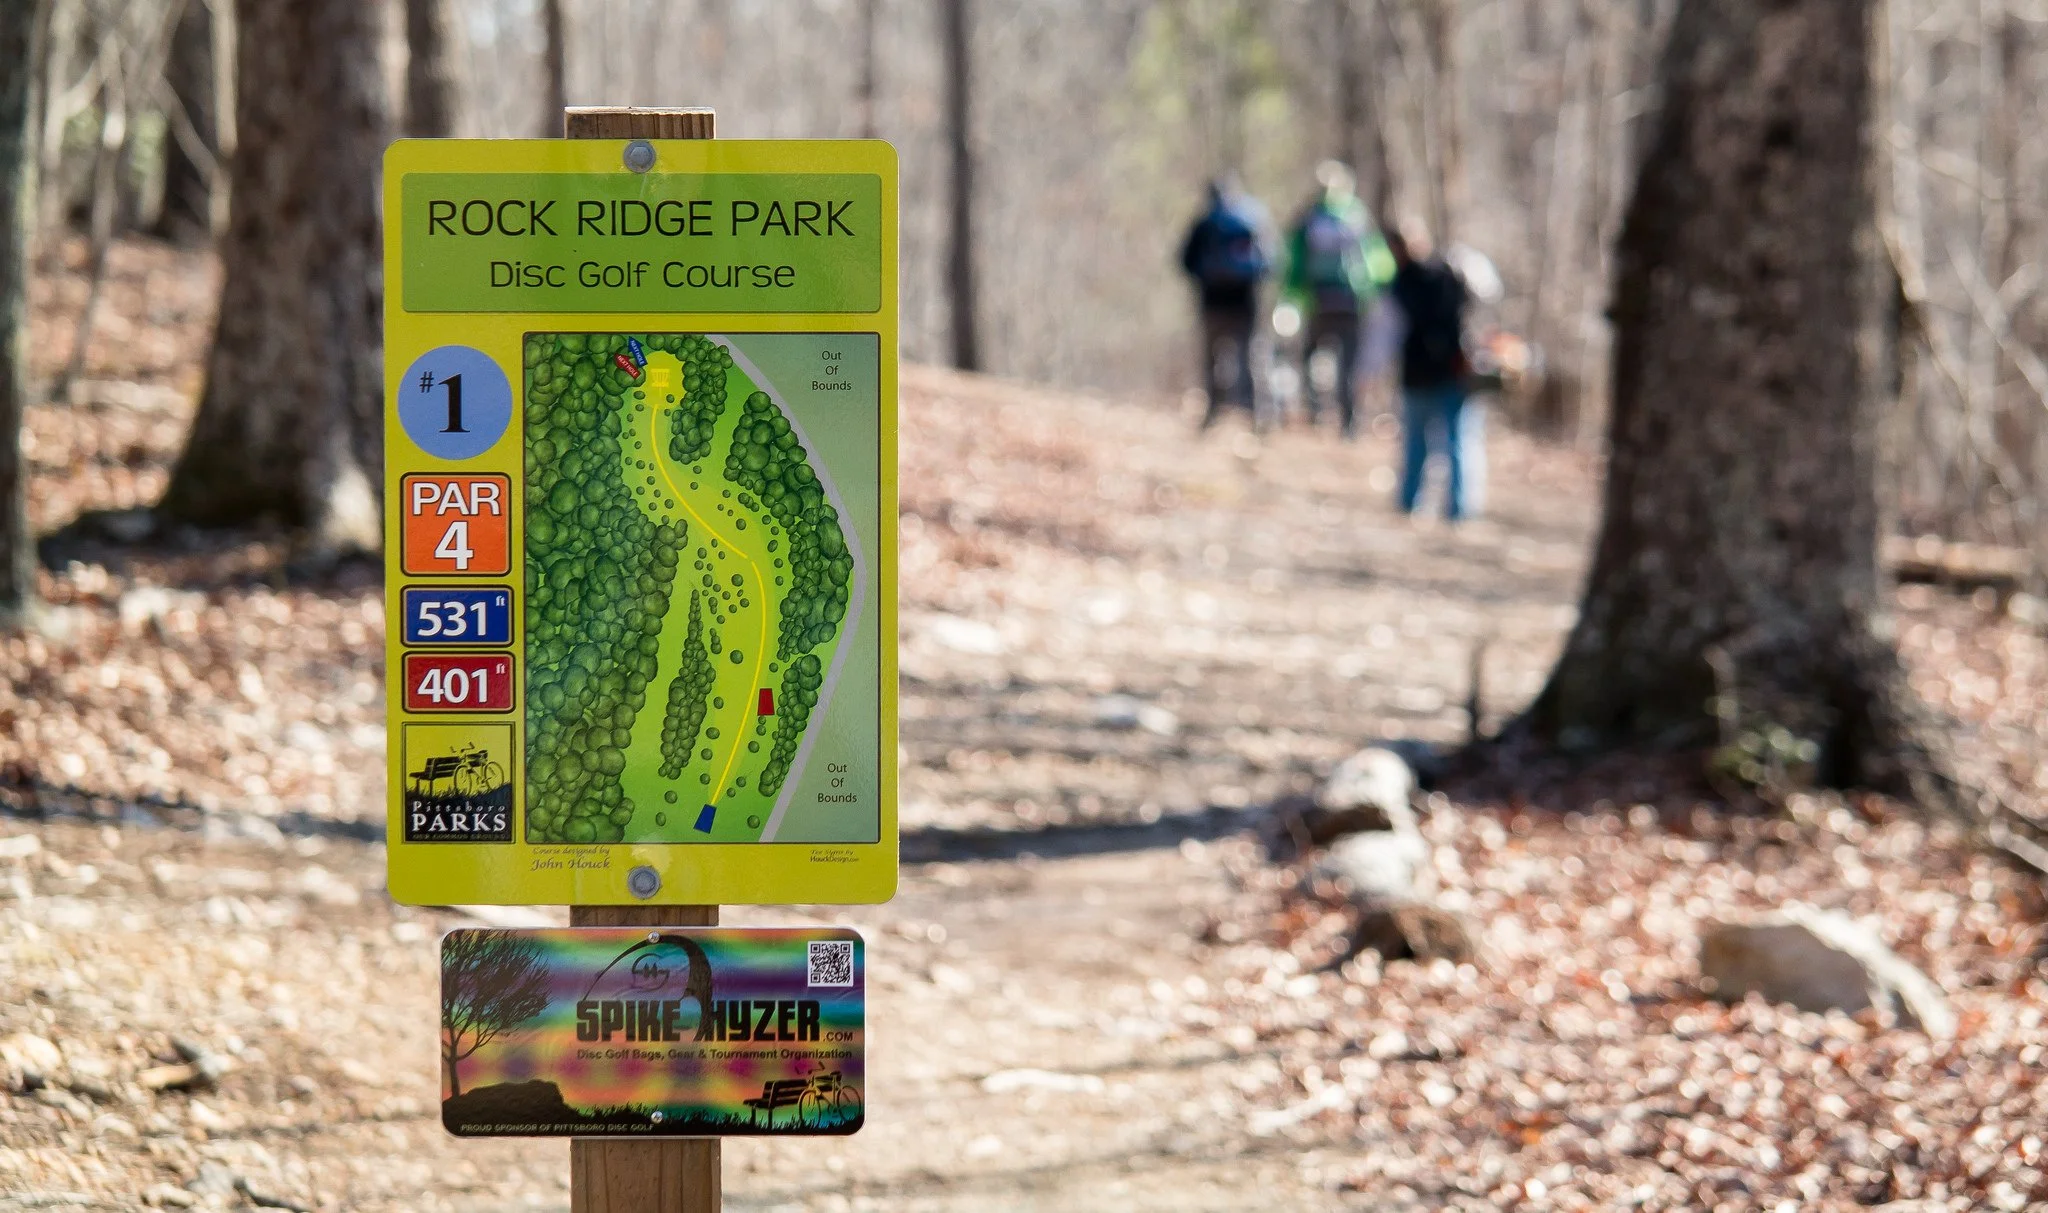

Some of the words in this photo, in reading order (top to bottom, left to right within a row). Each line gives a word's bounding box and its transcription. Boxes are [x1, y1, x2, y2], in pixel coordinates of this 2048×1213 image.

[428, 199, 558, 236] ROCK
[577, 199, 714, 236] RIDGE
[731, 199, 855, 236] PARK
[490, 260, 566, 288] Disc
[578, 260, 650, 288] Golf
[662, 260, 796, 288] Course
[821, 350, 842, 360] Out
[825, 365, 839, 375] Of
[811, 380, 852, 391] Bounds
[412, 481, 502, 517] PAR
[433, 519, 474, 571] 4
[417, 601, 487, 636] 531
[417, 668, 488, 703] 401
[827, 762, 848, 773] Out
[831, 777, 845, 788] Of
[817, 792, 858, 803] Bounds
[412, 800, 506, 812] Pittsboro
[411, 812, 507, 832] PARKS
[532, 847, 561, 855] Course
[562, 846, 597, 858] designed
[598, 846, 611, 857] by
[531, 858, 564, 872] John
[566, 858, 611, 870] Houck
[576, 1000, 681, 1042] SPIKE
[695, 1000, 821, 1042] HYZER
[576, 1048, 602, 1059] Disc
[605, 1048, 630, 1059] Golf
[632, 1048, 665, 1061] Bags,
[668, 1048, 695, 1059] Gear
[698, 1049, 707, 1059] &
[709, 1049, 778, 1060] Tournament
[781, 1049, 853, 1062] Organization
[461, 1124, 493, 1132] PROUD
[494, 1123, 538, 1132] SPONSOR
[539, 1123, 551, 1132] OF
[553, 1123, 606, 1132] PITTSBORO
[607, 1123, 628, 1132] DISC
[630, 1123, 655, 1132] GOLF
